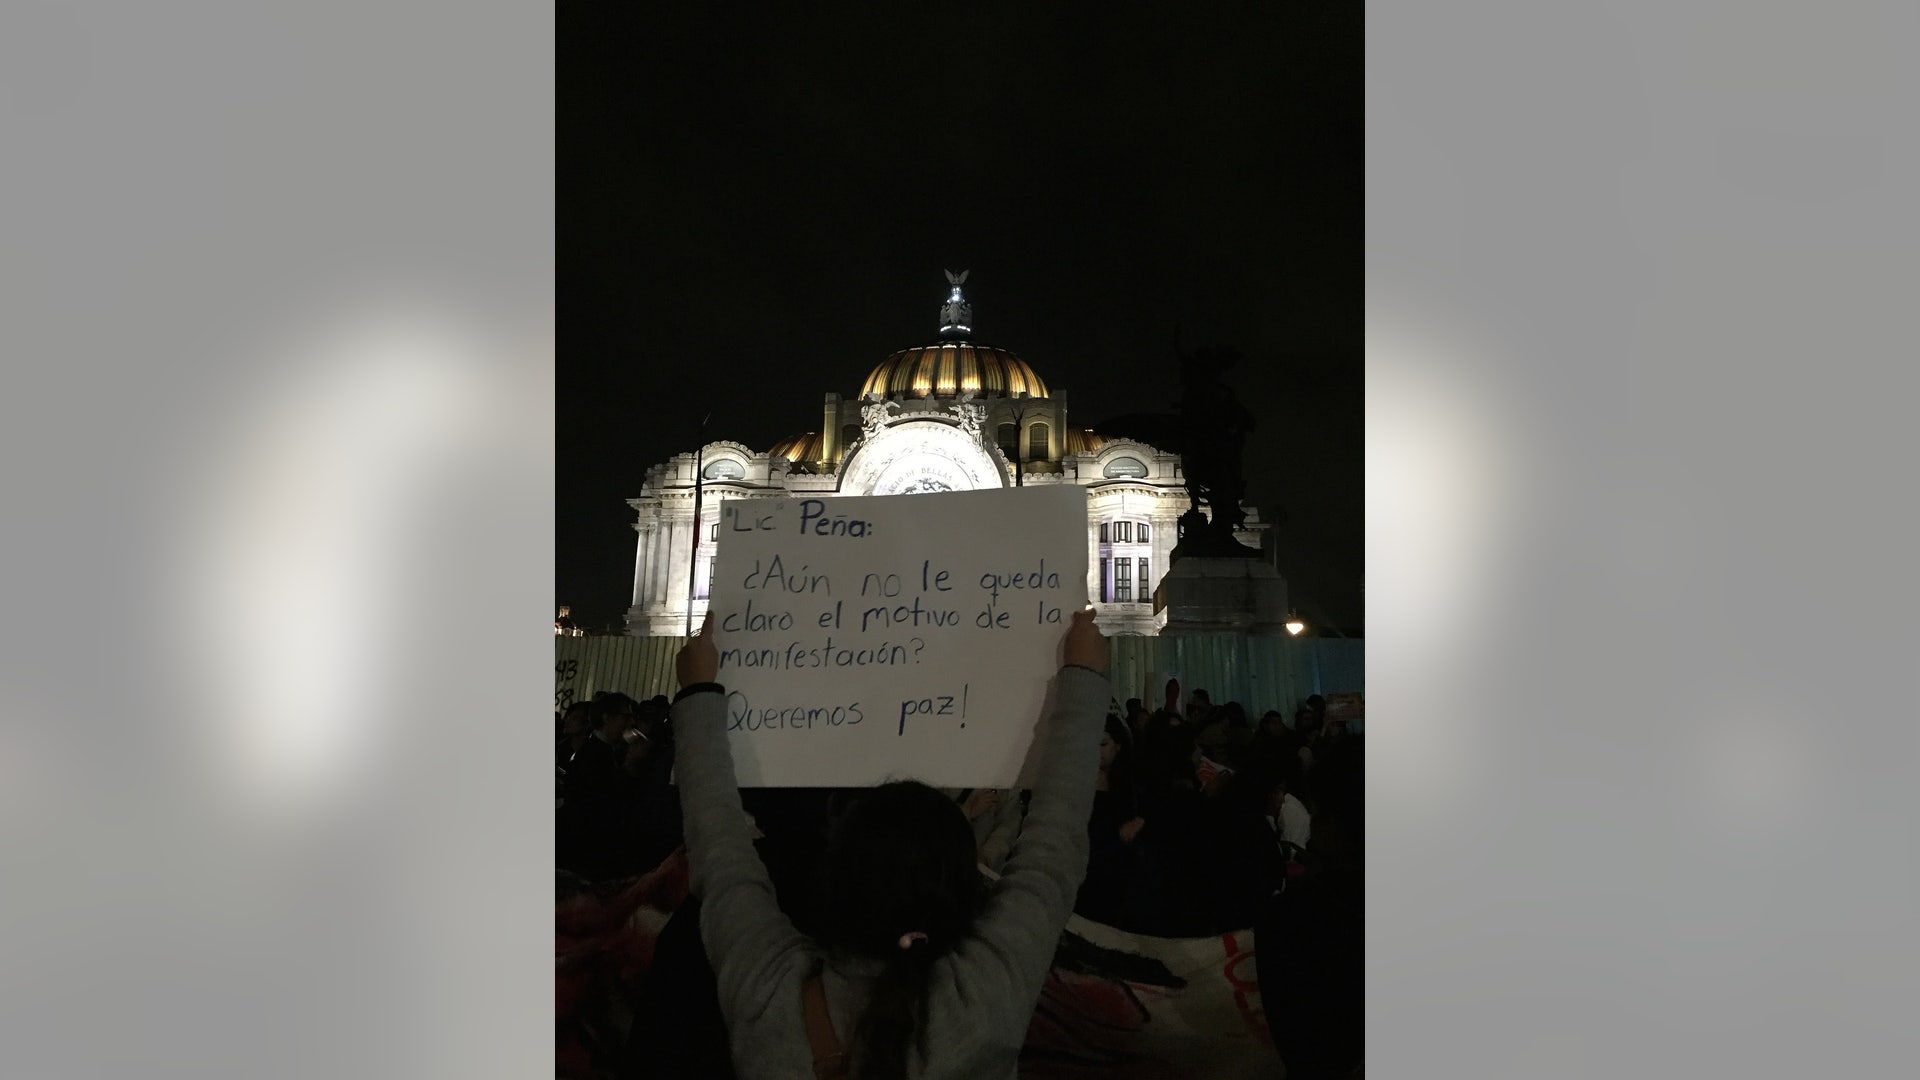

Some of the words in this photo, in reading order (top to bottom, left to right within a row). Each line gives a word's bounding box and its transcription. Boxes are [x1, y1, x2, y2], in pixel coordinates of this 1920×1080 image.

[800, 500, 873, 538] Peña:
[744, 554, 831, 597] ¿Aún
[861, 573, 901, 597] no
[922, 559, 953, 592] le
[980, 558, 1061, 609] queda
[722, 600, 794, 633] claro
[818, 600, 842, 629] el
[862, 597, 960, 633] motivo
[975, 602, 1011, 629] de
[1038, 601, 1062, 625] la
[555, 659, 578, 681] 43
[719, 636, 925, 671] manifestación?
[727, 690, 864, 732] Queremos
[899, 683, 969, 737] paz!
